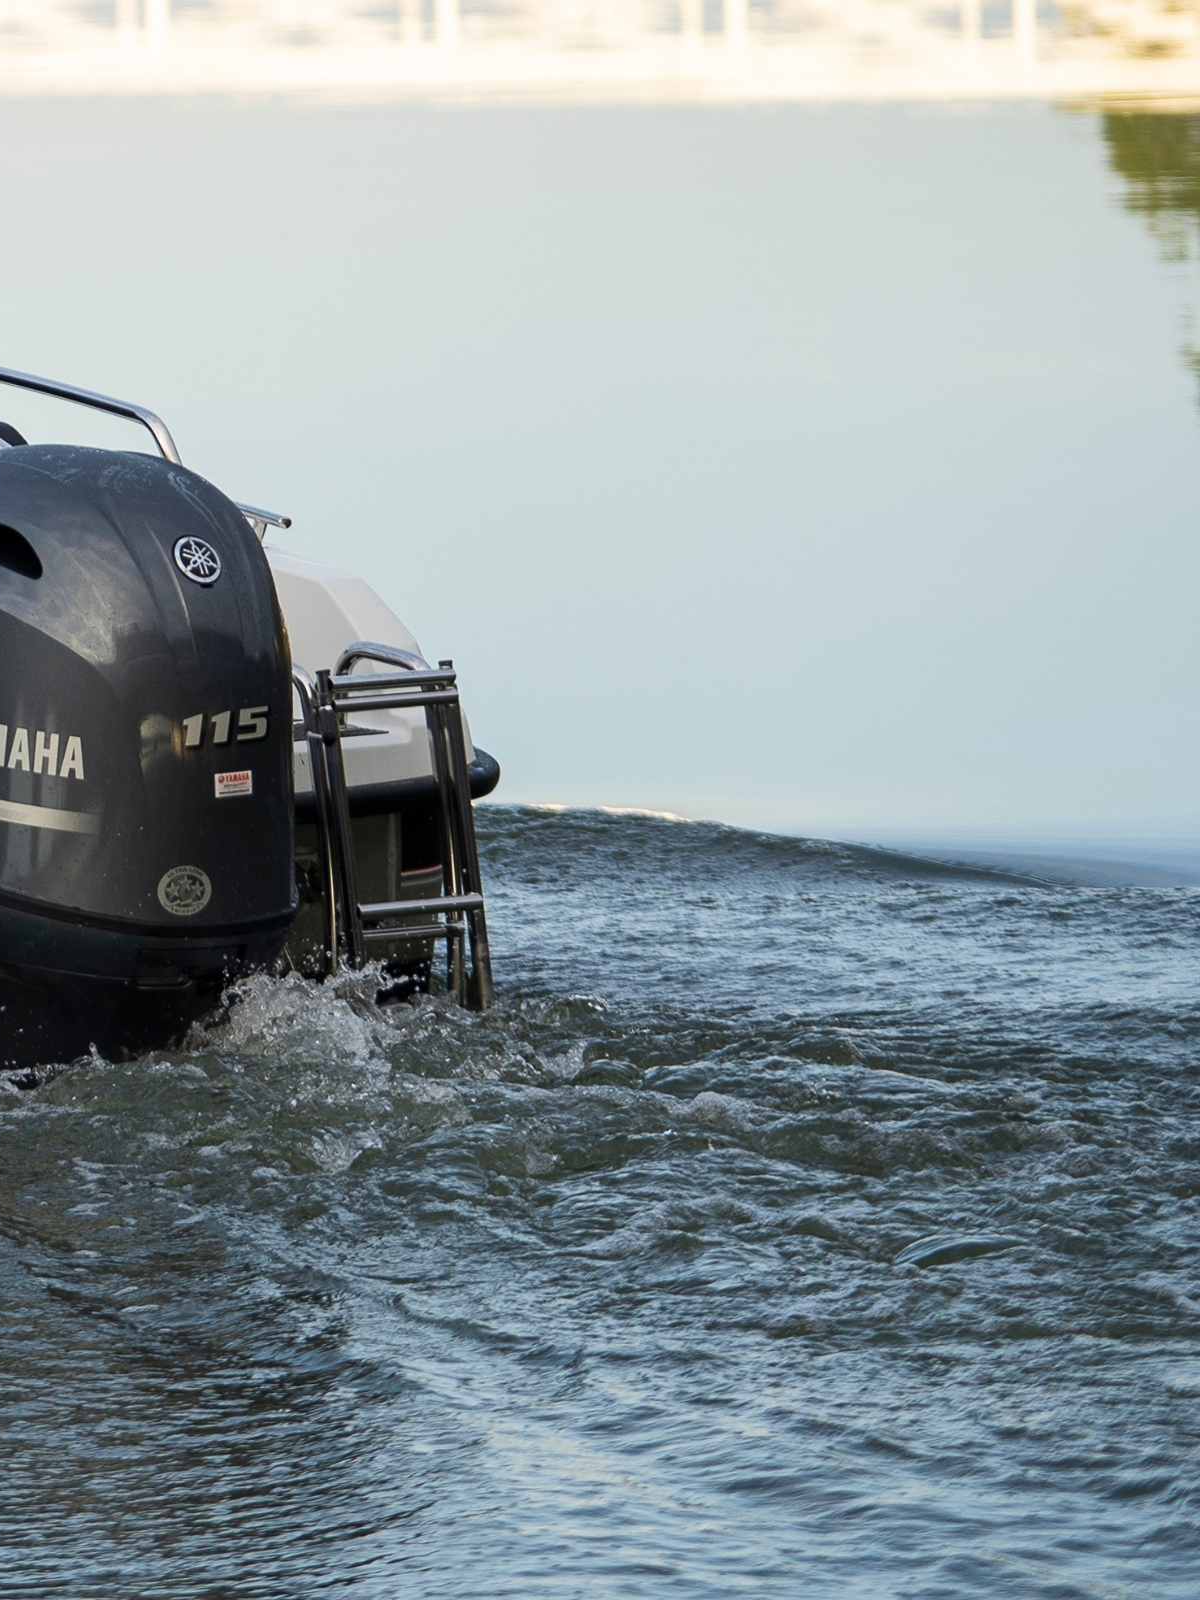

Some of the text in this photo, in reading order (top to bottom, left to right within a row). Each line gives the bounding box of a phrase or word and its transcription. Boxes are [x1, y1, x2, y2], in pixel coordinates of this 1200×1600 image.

[182, 705, 268, 747] 115
[224, 772, 250, 782] YAMAHA
[167, 866, 188, 879] ULTRA
